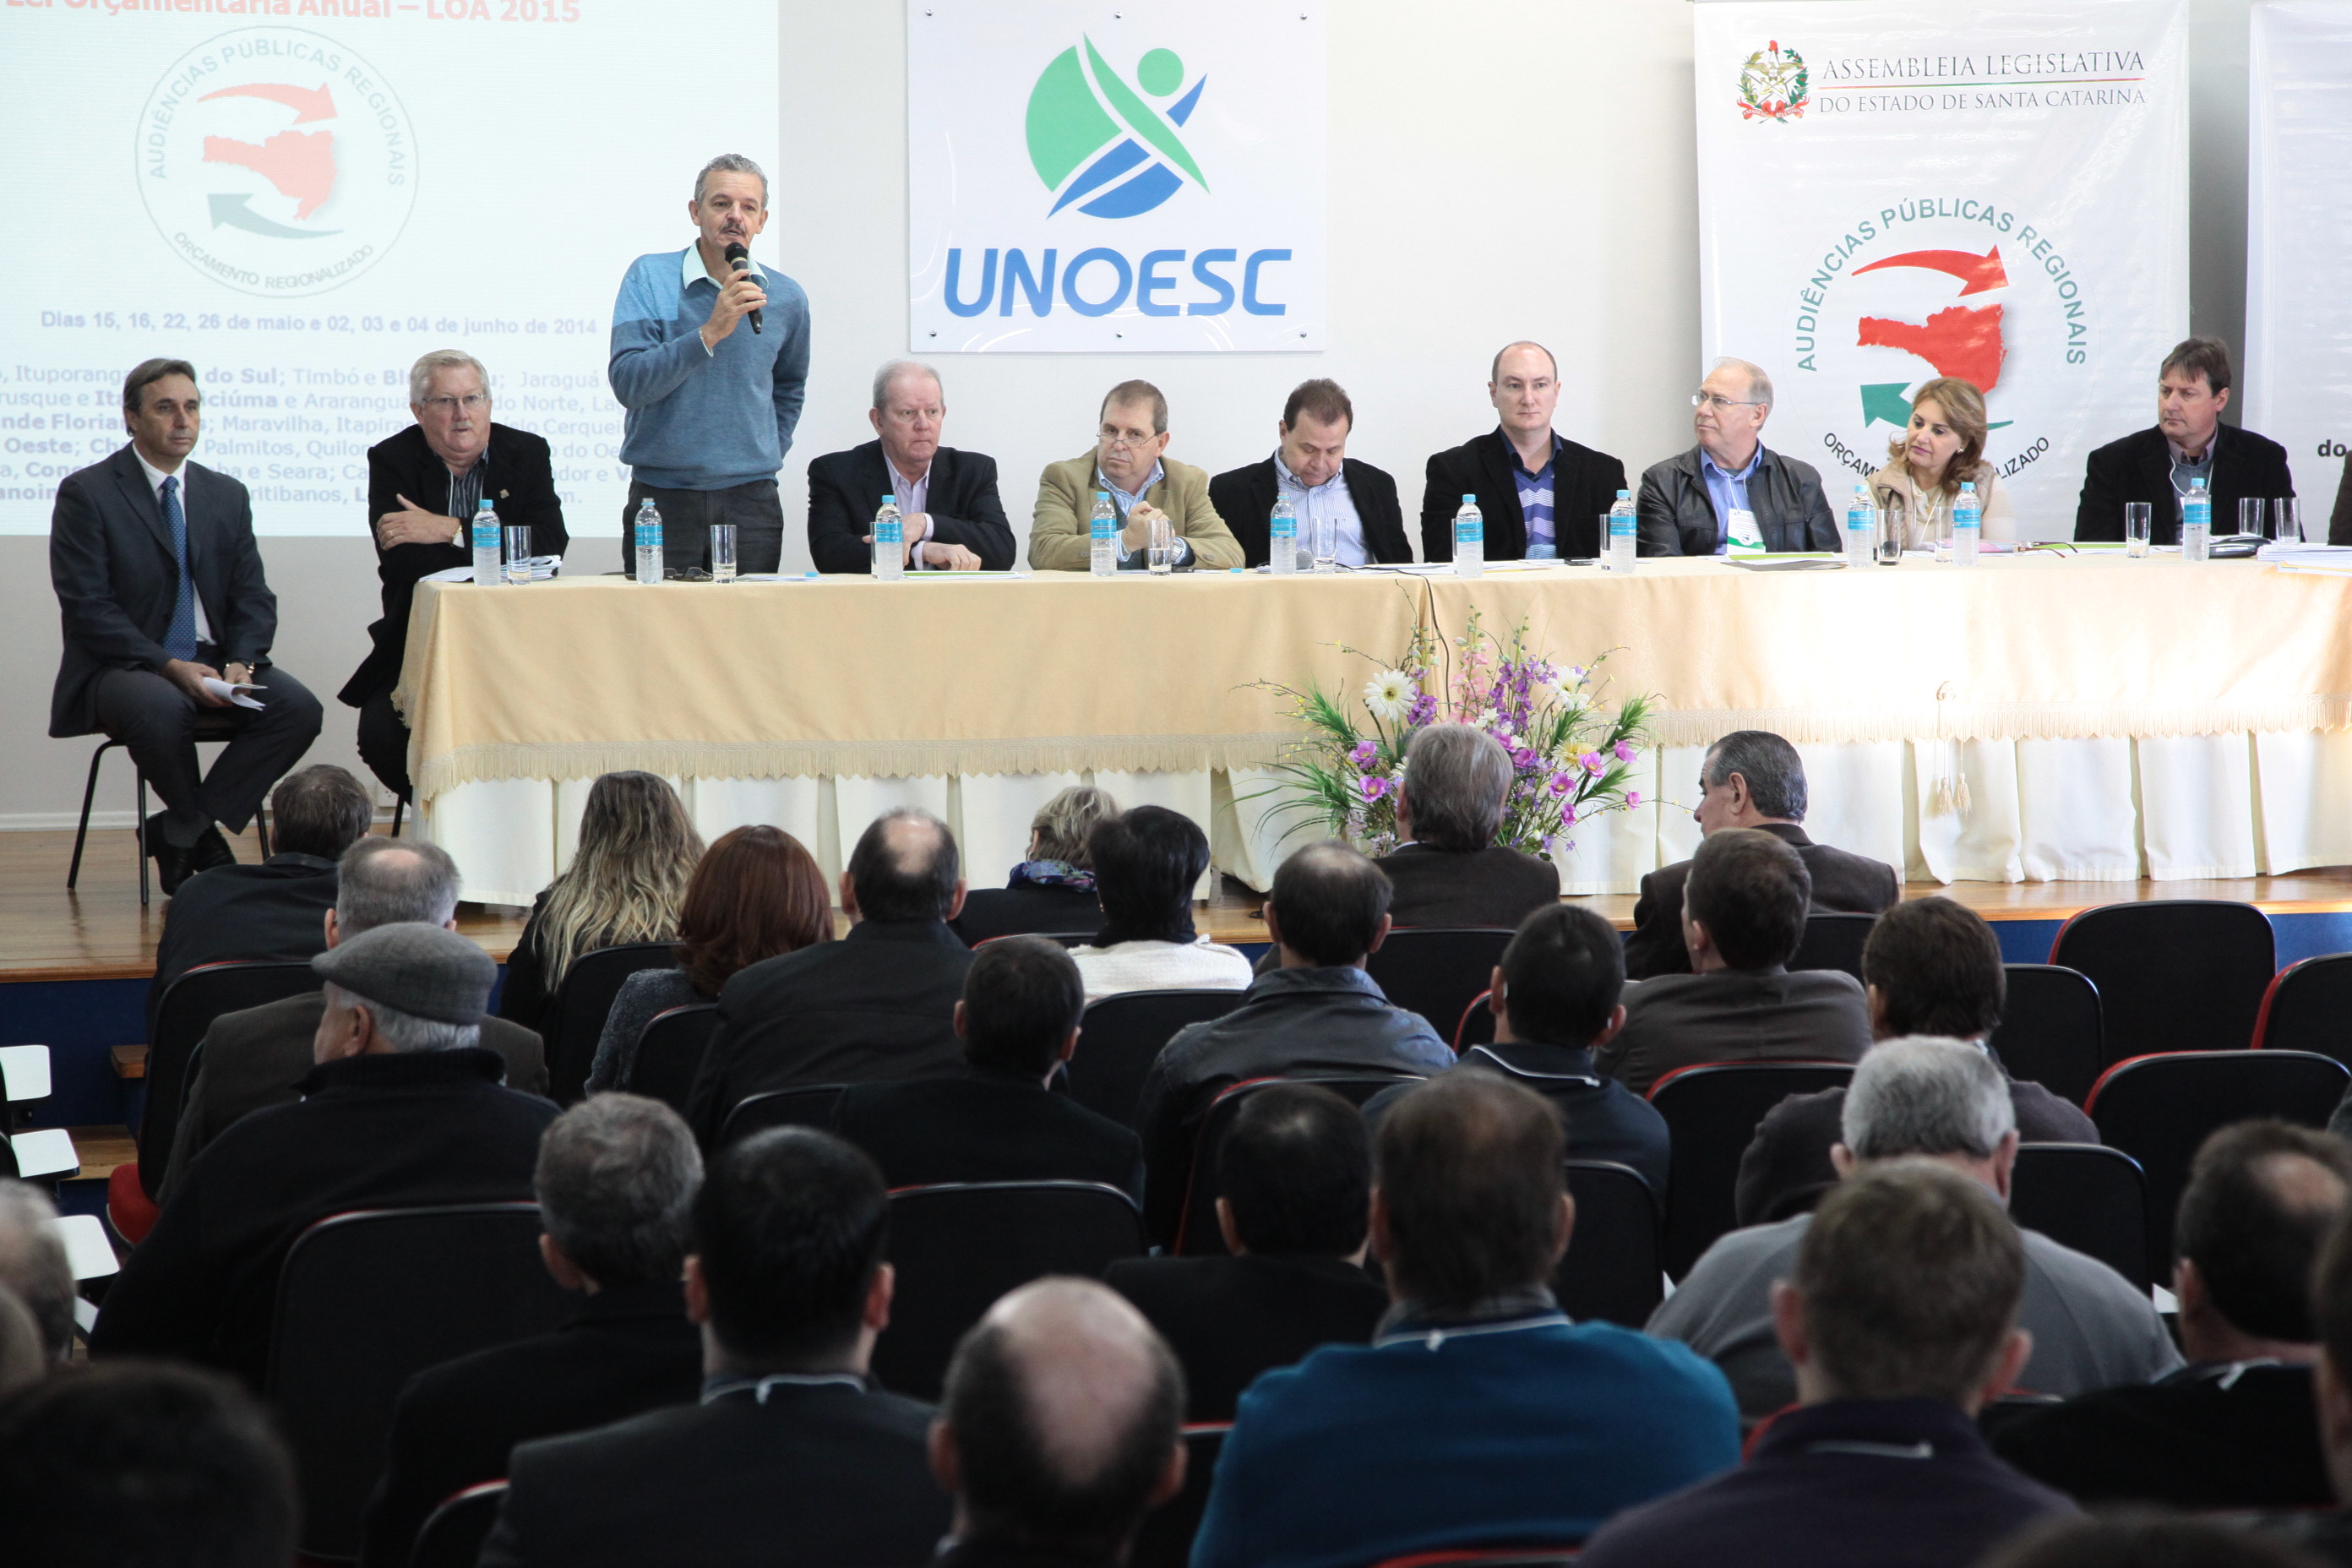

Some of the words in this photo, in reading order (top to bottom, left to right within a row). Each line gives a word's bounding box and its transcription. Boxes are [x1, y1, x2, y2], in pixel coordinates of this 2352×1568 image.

[297, 0, 391, 19] Anual
[427, 0, 492, 20] LOA
[500, 0, 580, 23] 2015
[1822, 56, 1976, 79] ASSEMBLEIA
[1986, 51, 2145, 75] LEGISLATIVA
[148, 56, 218, 179] AUDIÊNCIAS
[221, 38, 341, 72] PÚBLICAS
[345, 66, 406, 186] REGIONAIS
[1820, 96, 1850, 112] DO
[1859, 95, 1935, 112] ESTADO
[1942, 93, 1967, 110] DE
[1975, 92, 2039, 109] SANTA
[2045, 89, 2146, 106] CATARINA
[173, 231, 259, 286] ORÇAMENTO
[944, 247, 1293, 318] UNOESC
[1796, 220, 1876, 372] AUDIÊNCIAS
[1881, 198, 2014, 232] PÚBLICAS
[2017, 225, 2087, 365] REGIONAIS
[41, 310, 85, 328] Dias
[94, 312, 121, 330] 15,
[129, 313, 156, 331] 16,
[163, 313, 191, 331] 22,
[198, 313, 220, 329] 26
[227, 313, 250, 330] de
[257, 314, 305, 331] maio
[310, 318, 321, 331] e
[327, 315, 355, 334] 02,
[362, 316, 384, 332] 03
[390, 319, 401, 332] e
[407, 317, 428, 333] 04
[435, 317, 458, 333] de
[462, 318, 519, 336] junho
[525, 317, 548, 334] de
[553, 318, 597, 335] 2014
[204, 367, 233, 384] do
[241, 367, 286, 387] Sul;
[291, 367, 359, 385] Timbó
[364, 373, 376, 385] e
[520, 369, 599, 391] Jaraguá
[0, 392, 71, 409] rusque
[76, 393, 89, 406] e
[201, 389, 278, 407] iciúma
[285, 395, 297, 408] e
[493, 394, 516, 411] do
[522, 395, 585, 415] Norte,
[543, 418, 622, 438] Cerquei
[4, 437, 81, 457] Oeste;
[563, 441, 589, 458] do
[1824, 433, 1881, 479] ORÇAM
[1995, 436, 2050, 480] LIZADO
[250, 485, 348, 505] ritibanos,
